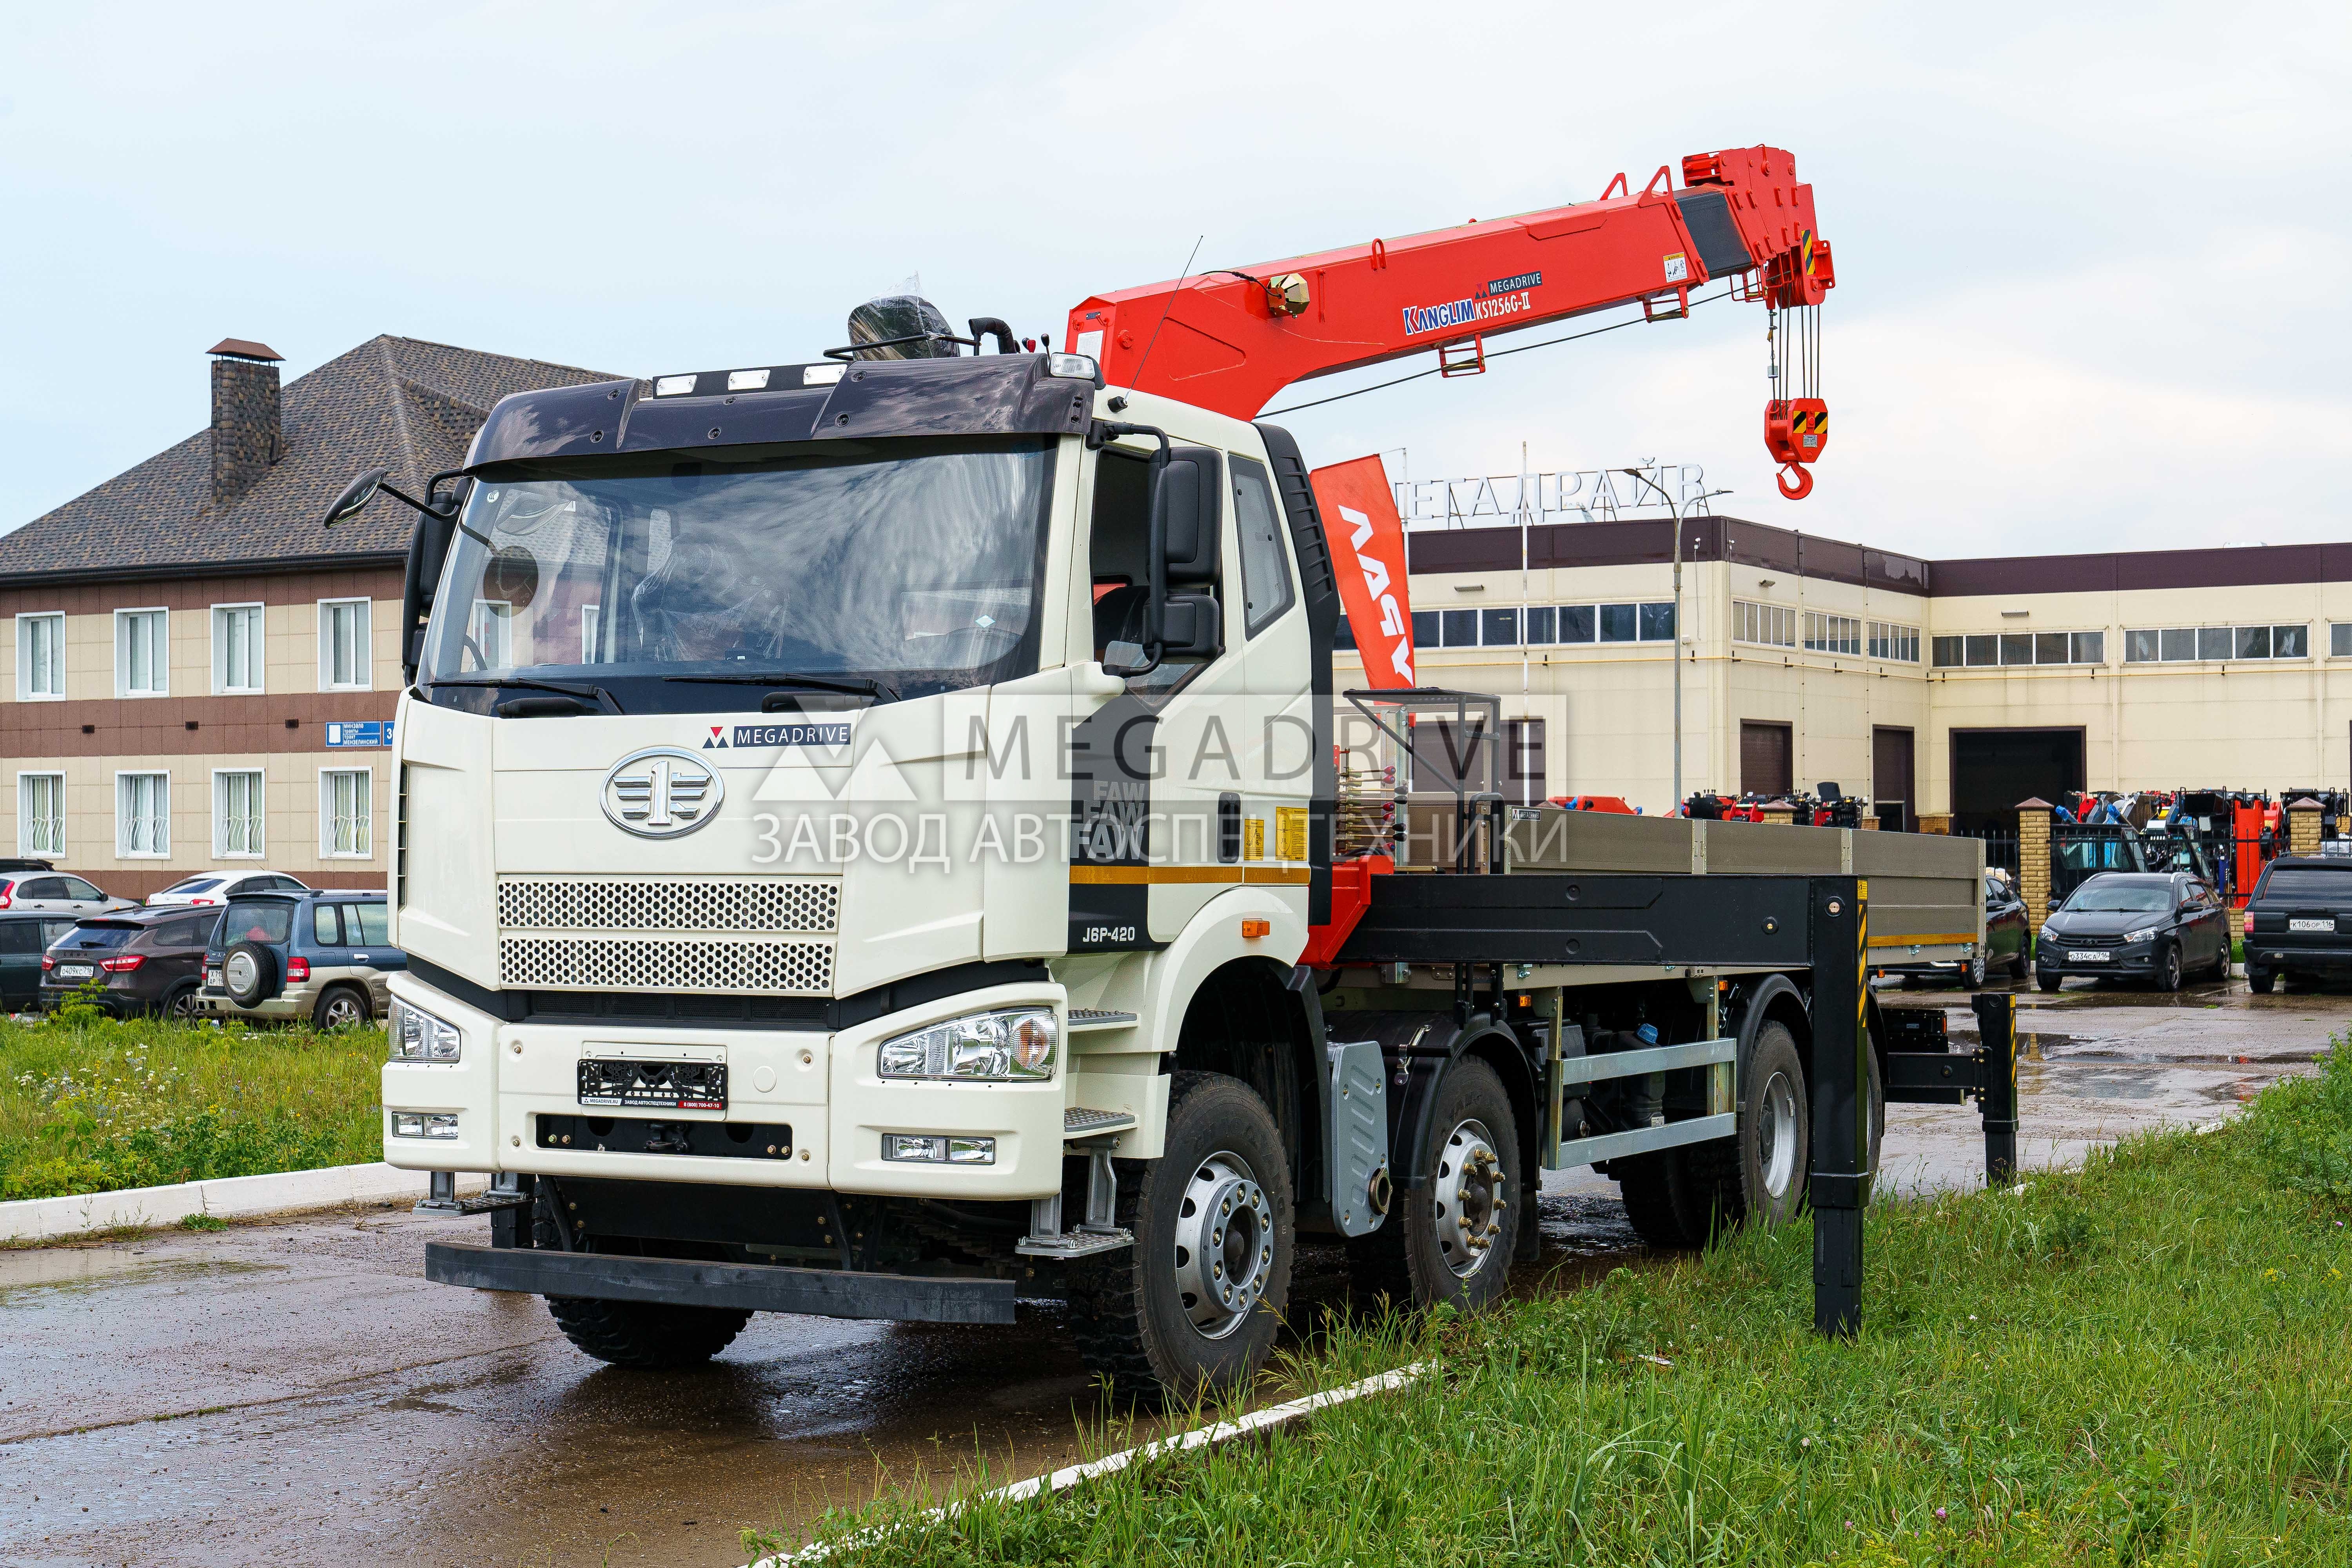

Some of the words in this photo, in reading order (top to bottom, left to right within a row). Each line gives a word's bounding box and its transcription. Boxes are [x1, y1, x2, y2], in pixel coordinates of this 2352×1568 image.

[1490, 272, 1541, 294] MEGADRIVE
[1403, 298, 1475, 336] KANGLIM
[1394, 457, 1704, 524] ЕГАДРАЙВ
[737, 726, 848, 745] MEGADRIVE
[1094, 781, 1145, 808] FAW
[1083, 800, 1144, 831] FAW
[1070, 823, 1144, 859] FAW
[1083, 927, 1135, 942] J6P-420
